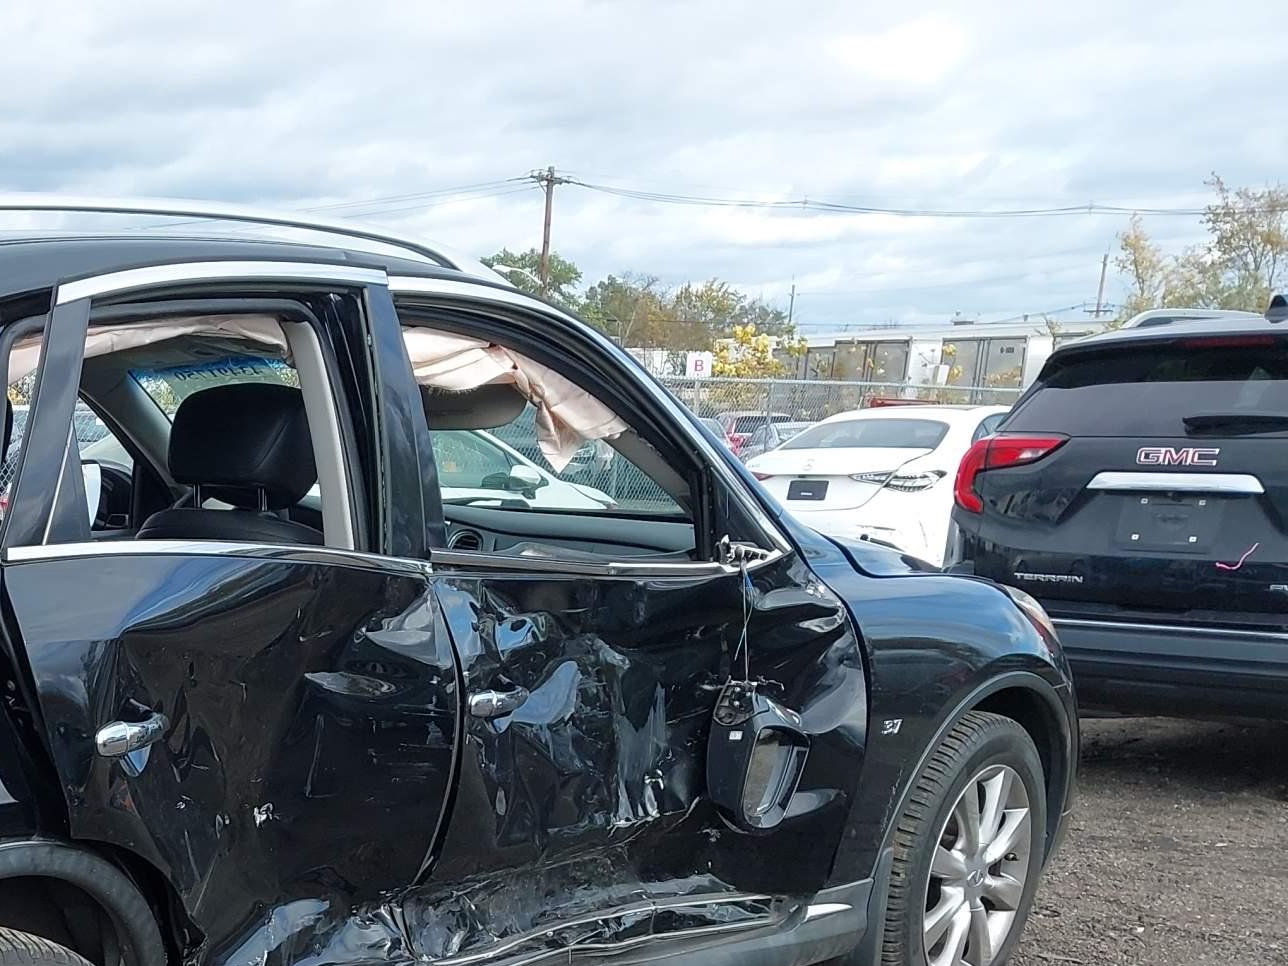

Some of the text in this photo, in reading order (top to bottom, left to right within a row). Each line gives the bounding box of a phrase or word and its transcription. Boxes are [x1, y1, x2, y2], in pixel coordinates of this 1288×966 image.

[694, 359, 704, 372] B
[1136, 447, 1220, 466] GMC
[1013, 572, 1084, 583] TERRAIN
